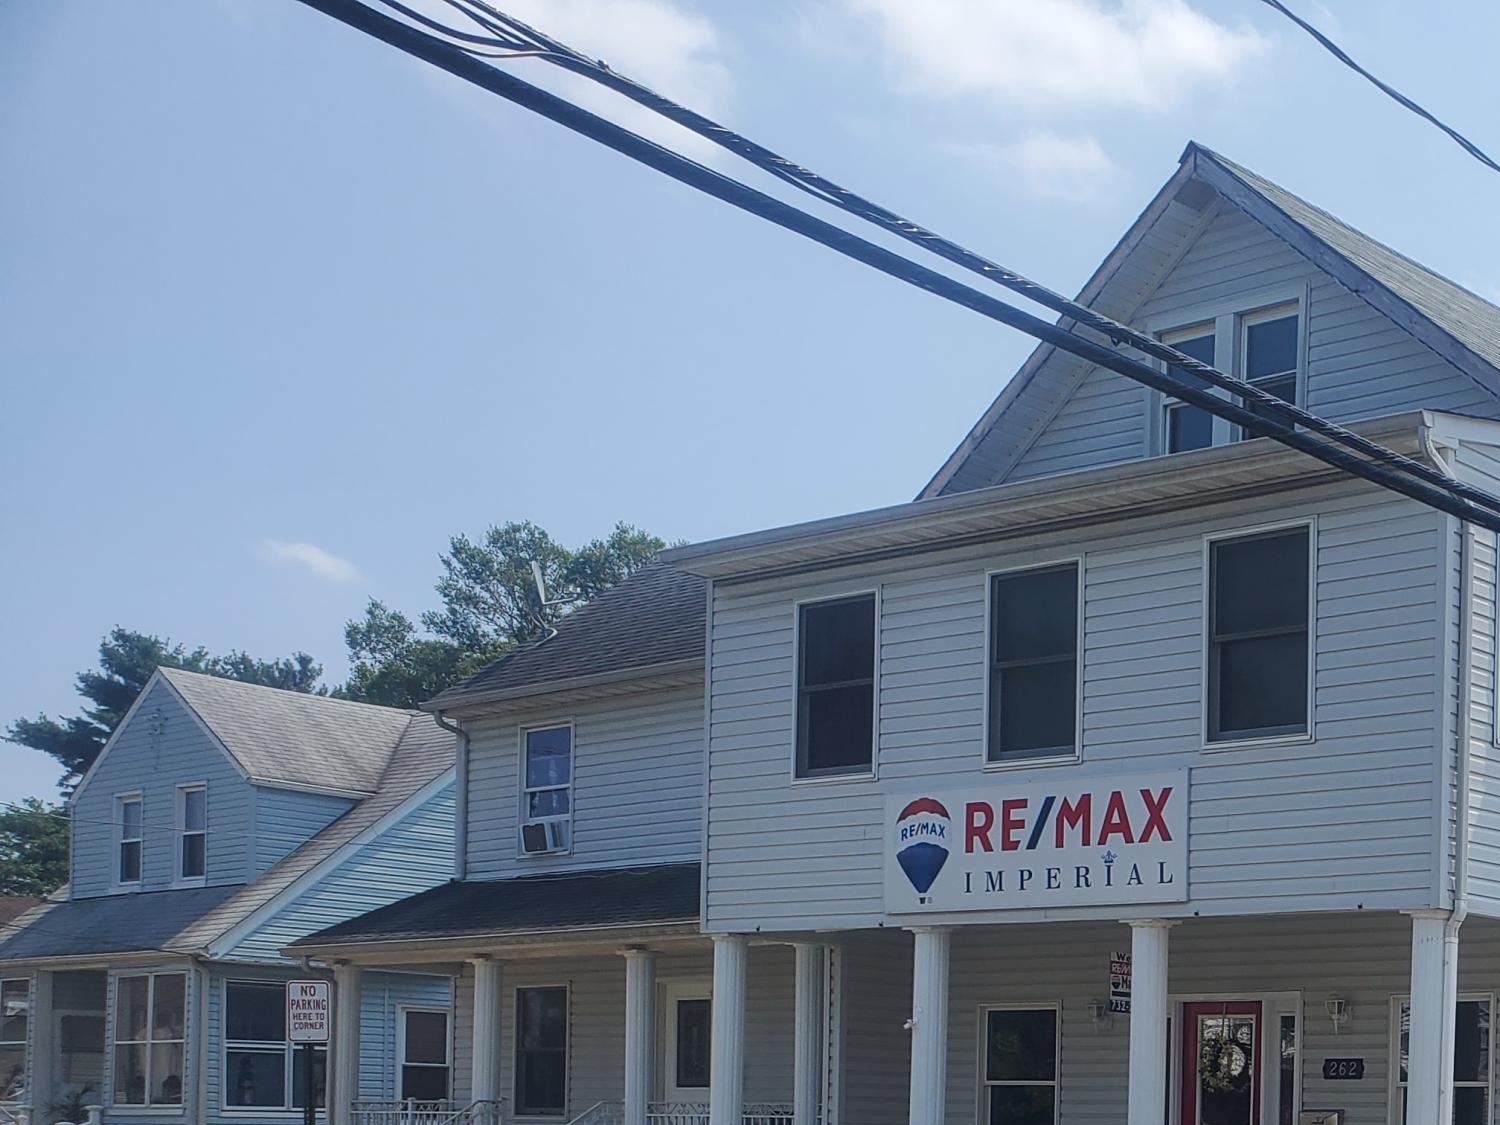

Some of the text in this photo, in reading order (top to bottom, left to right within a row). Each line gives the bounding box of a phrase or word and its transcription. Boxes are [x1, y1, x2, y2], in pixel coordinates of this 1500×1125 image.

[965, 787, 1173, 854] RE/MAX
[901, 822, 946, 841] RE/MAX
[964, 859, 1173, 894] IMPERIAL
[301, 985, 316, 996] NO
[291, 999, 326, 1010] PARKING
[293, 1012, 325, 1020] HERE TO
[294, 1022, 324, 1030] CORNER
[1329, 1061, 1357, 1075] 262
